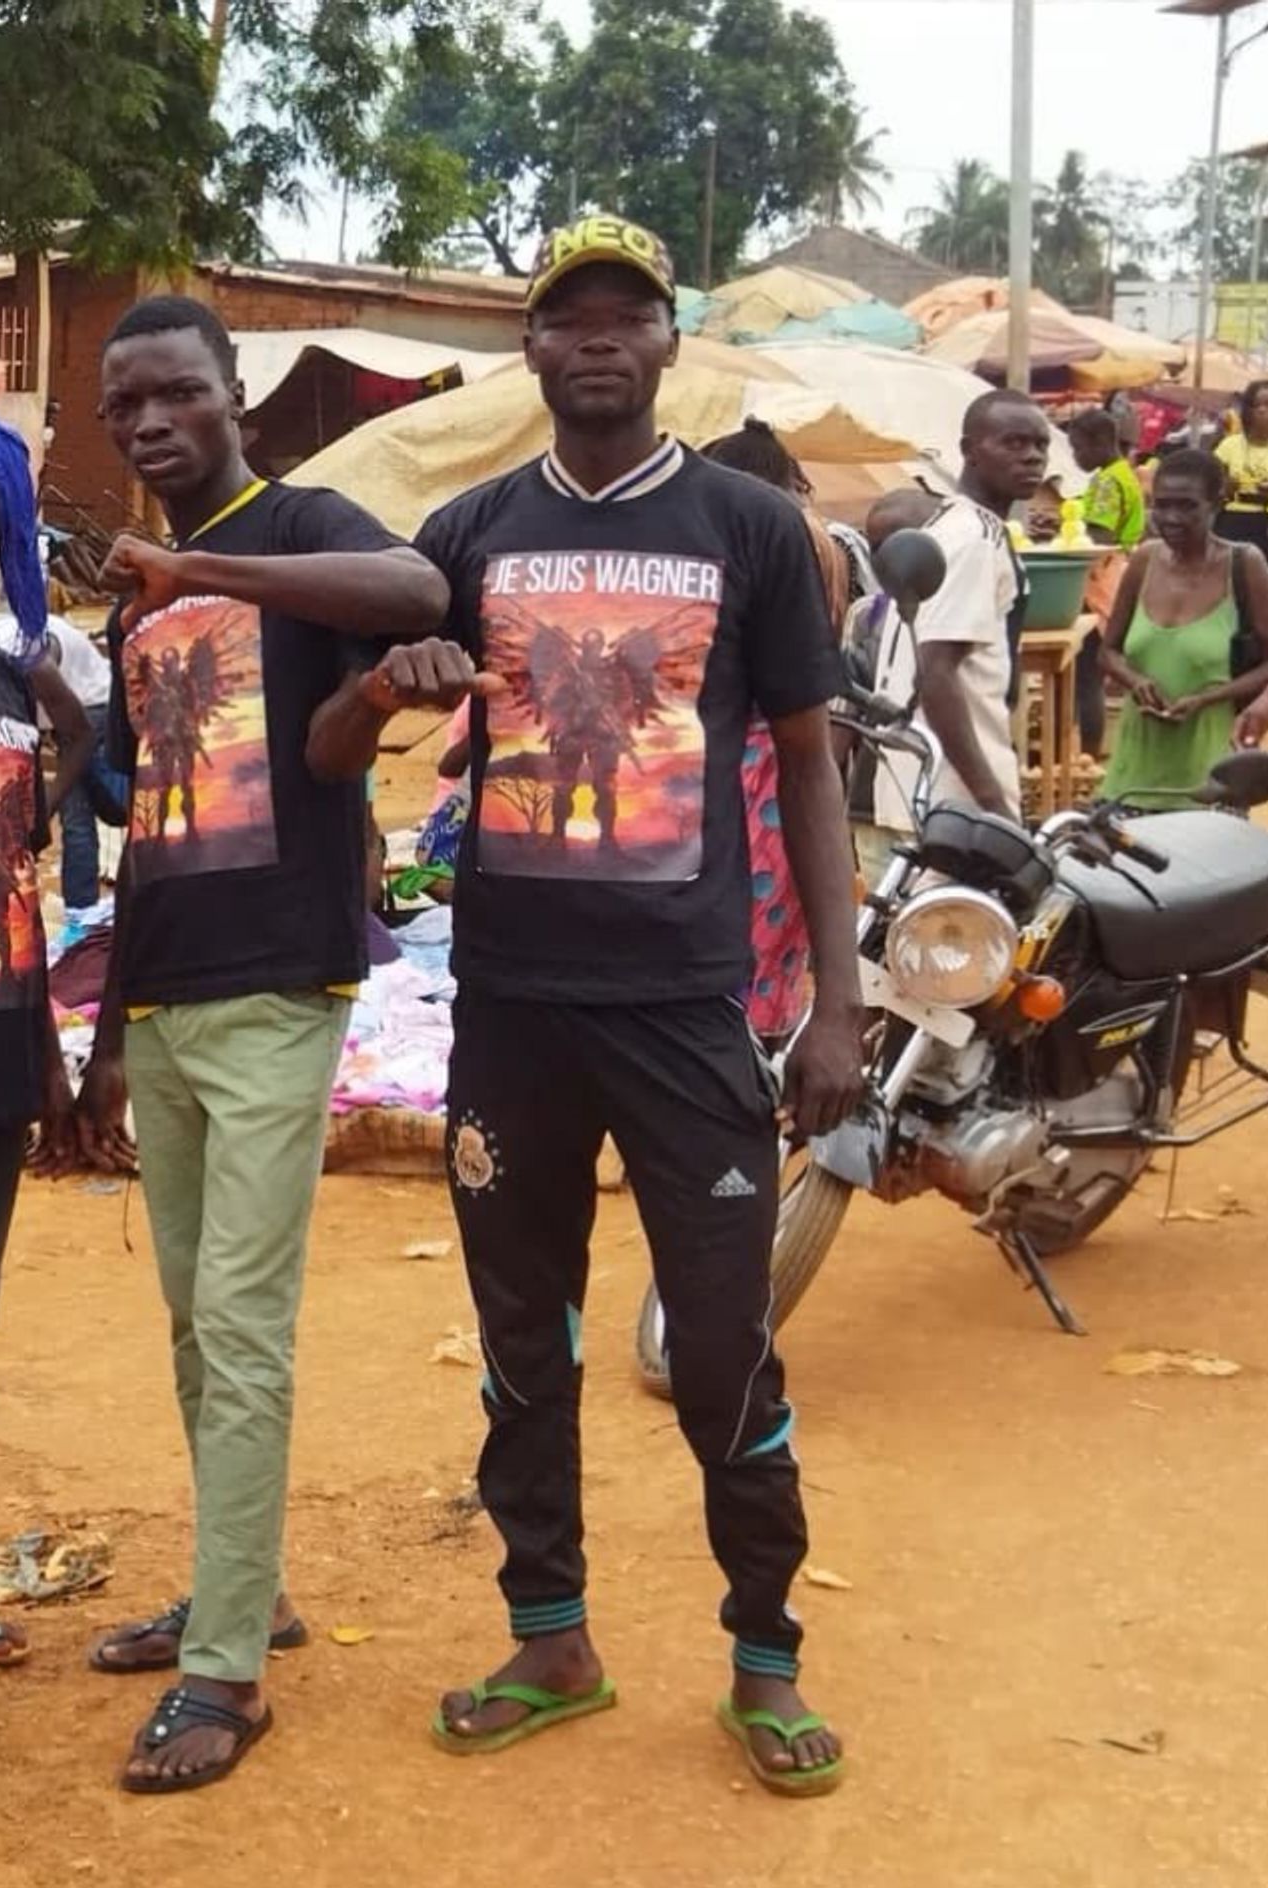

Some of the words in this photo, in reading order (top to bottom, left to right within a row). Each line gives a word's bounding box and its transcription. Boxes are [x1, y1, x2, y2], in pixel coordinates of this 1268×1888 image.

[553, 217, 655, 266] NEO
[490, 558, 522, 595] JE
[525, 556, 587, 593] SUIS
[595, 556, 720, 600] WAGNER
